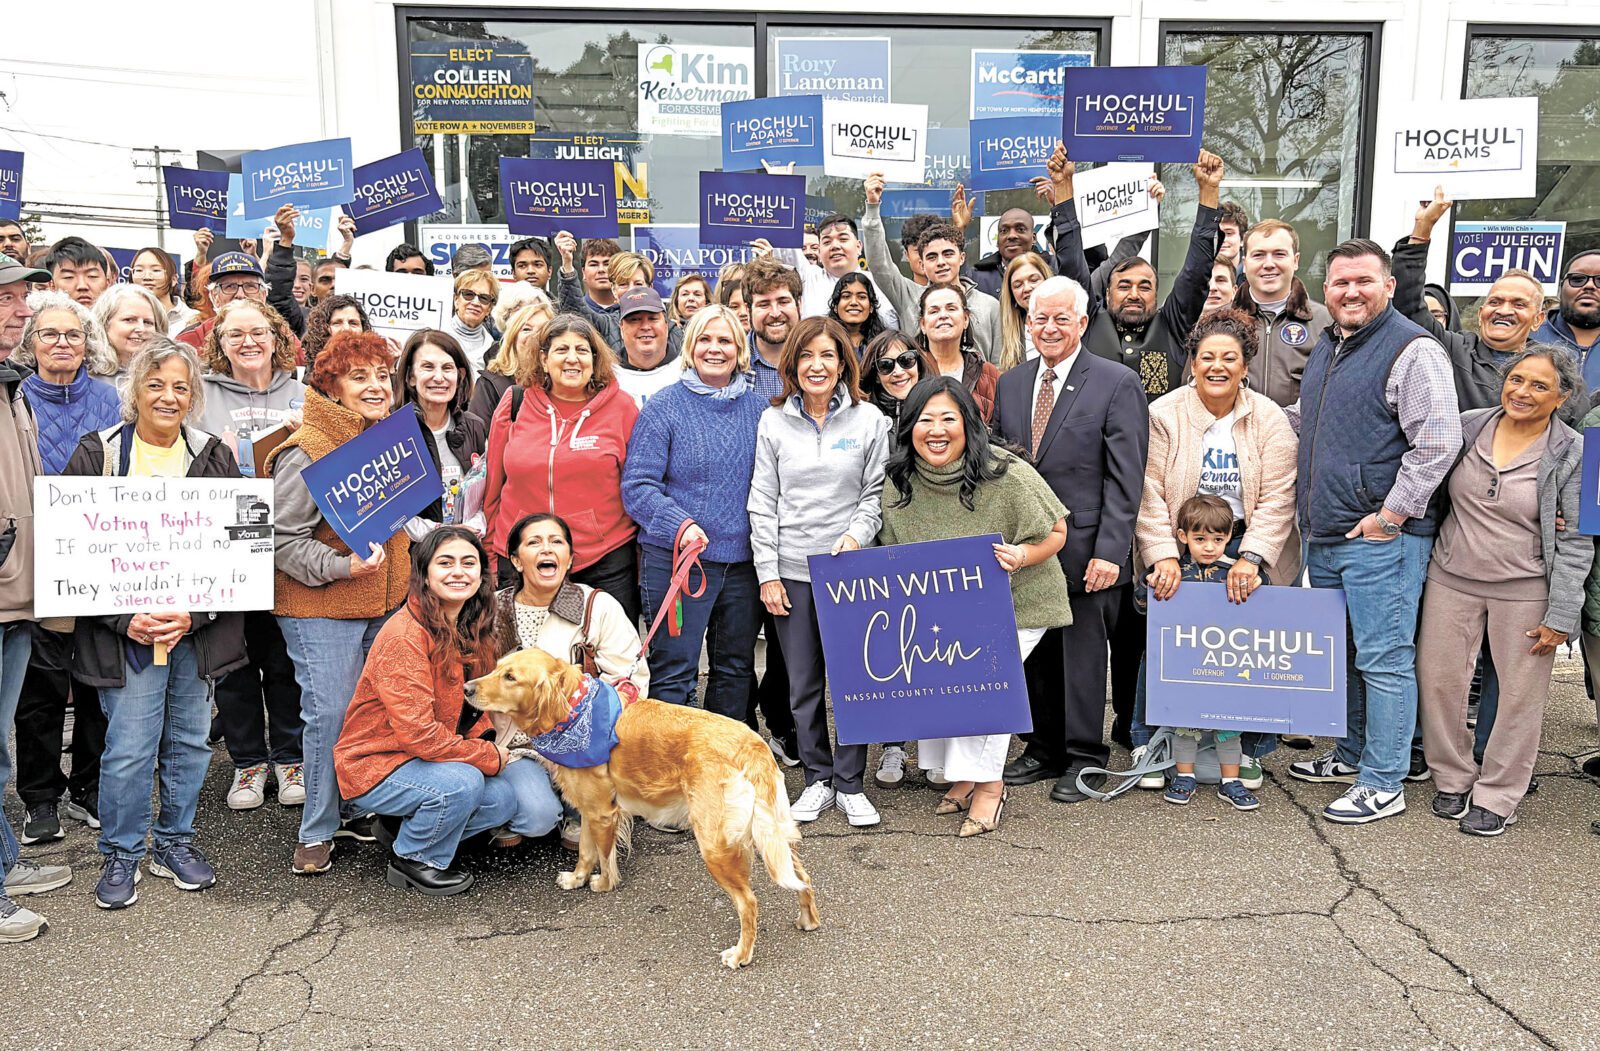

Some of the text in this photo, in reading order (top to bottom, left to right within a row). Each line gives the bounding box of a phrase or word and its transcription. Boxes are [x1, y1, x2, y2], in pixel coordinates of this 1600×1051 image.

[449, 49, 493, 61] ELECT
[681, 53, 748, 85] Kim
[783, 54, 837, 76] Rory
[434, 69, 511, 84] COLLEEN
[783, 72, 885, 90] Lancman
[978, 66, 1065, 84] McCarth
[415, 84, 532, 99] CONNAUGHTON
[640, 81, 751, 102] Keiserman
[661, 105, 721, 115] FOR ASSEMB
[1085, 94, 1187, 111] HOCHUL
[710, 118, 720, 126] U
[737, 115, 808, 134] HOCHUL
[1103, 112, 1165, 124] ADAMS
[750, 128, 793, 141] ADAMS
[838, 123, 911, 141] HOCHUL
[1405, 127, 1515, 146] HOCHUL
[574, 136, 604, 145] ELECT
[850, 138, 894, 150] ADAMS
[987, 136, 1057, 152] HOCHUL
[555, 146, 623, 160] JULEIGH
[1001, 149, 1047, 160] ADAMS
[1424, 146, 1491, 160] ADAMS
[925, 155, 971, 168] CHUL
[260, 159, 338, 182] HOCHUL
[925, 170, 954, 179] AMS
[274, 172, 322, 187] ADAMS
[354, 170, 419, 200] HOCHUL
[181, 186, 229, 202] HOCH
[368, 185, 407, 205] ADAMS
[517, 181, 599, 196] HOCHUL
[1086, 180, 1144, 206] HOCHUL
[195, 199, 228, 210] ADAM
[533, 196, 582, 207] ADAMS
[616, 200, 648, 208] SLATOR
[715, 193, 790, 209] HOCHUL
[1098, 196, 1133, 213] ADAMS
[728, 208, 774, 218] ADAMS
[1458, 234, 1555, 246] VOTE! JULEIGH
[641, 248, 747, 266] DiNAPOLI
[1455, 246, 1554, 278] CHIN
[354, 292, 437, 312] HOCHUL
[368, 308, 419, 320] ADAMS
[332, 442, 413, 504] HOCHUL
[356, 466, 402, 506] ADAMS
[1200, 483, 1237, 491] ASSEMBLY
[49, 482, 239, 507] Don't Tread on our
[83, 513, 149, 540] Voting
[161, 511, 212, 536] Rights
[238, 530, 259, 538] VOTE
[56, 532, 231, 554] If our vote had no
[112, 557, 170, 573] Power
[54, 569, 247, 601] They wouldn't try to
[826, 566, 983, 604] WIN WITH
[114, 595, 176, 607] Silence
[189, 593, 213, 606] us
[864, 604, 981, 684] Chin
[1176, 625, 1324, 655] HOCHUL
[1202, 650, 1292, 671] ADAMS
[1192, 668, 1225, 677] GOVERNOR
[1264, 672, 1271, 680] LT
[845, 682, 1009, 702] NASSAU COUNTY LEGISLATOR
